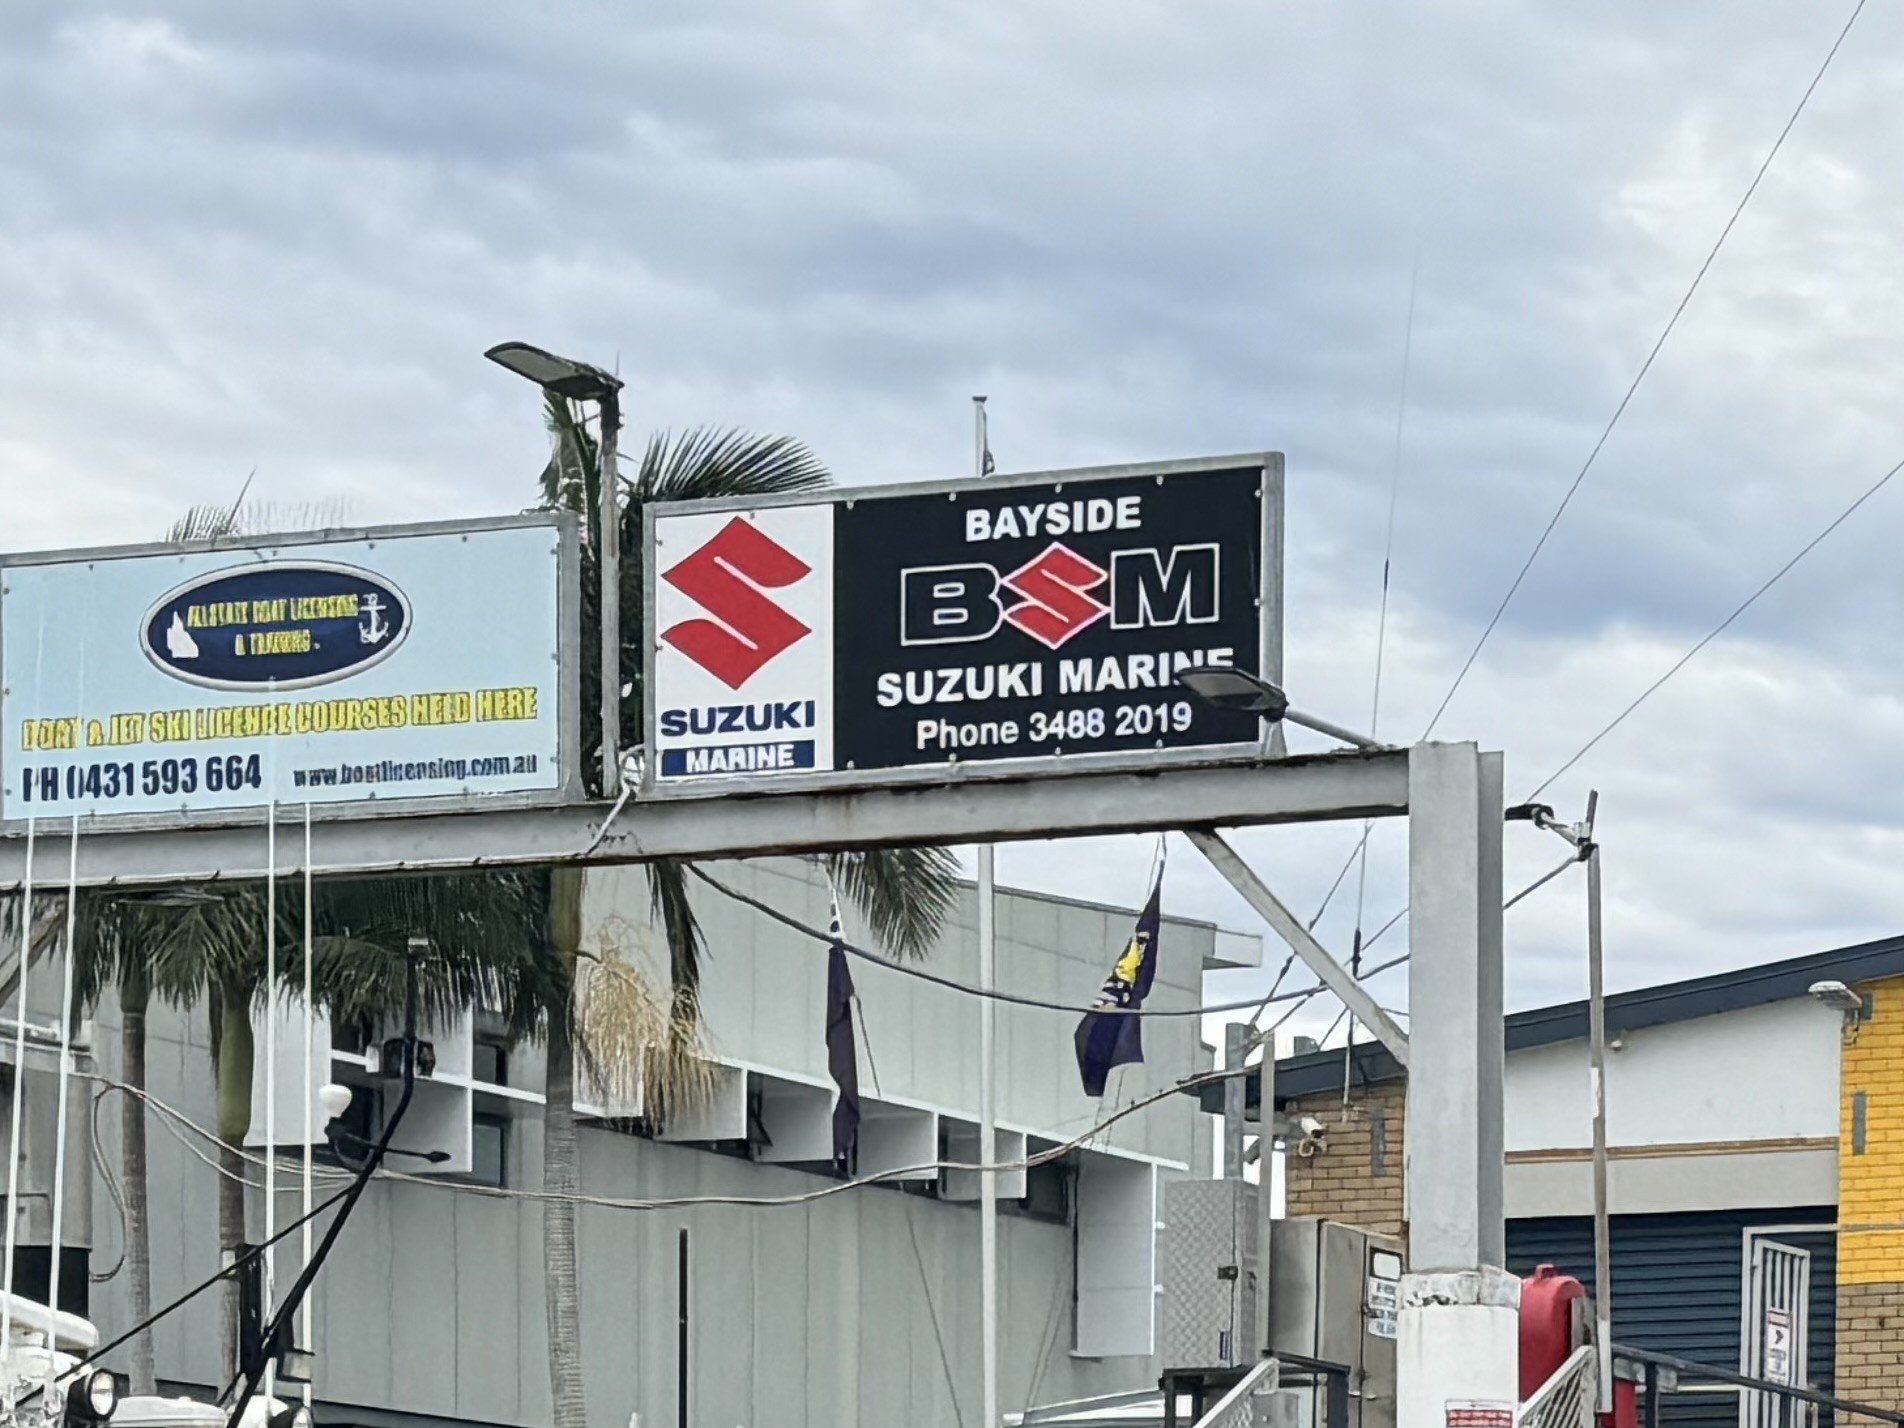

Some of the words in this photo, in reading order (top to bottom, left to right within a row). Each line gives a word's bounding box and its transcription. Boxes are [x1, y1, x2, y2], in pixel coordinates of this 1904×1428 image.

[966, 496, 1141, 541] BAYSIDE
[876, 661, 1042, 707] SUZUKI
[109, 713, 145, 745] JET
[149, 709, 191, 743] SKI
[296, 695, 407, 733] COURSES
[411, 692, 470, 725] HELD
[476, 687, 538, 722] HERE
[660, 701, 816, 737] SUZUKI
[916, 715, 1019, 749] Phone
[1029, 709, 1105, 741] 3488
[1115, 702, 1192, 737] 2019
[23, 767, 59, 802] PH
[66, 762, 134, 799] 0431
[142, 758, 197, 796] 593
[205, 754, 262, 791] 664
[685, 742, 795, 772] MARINE
